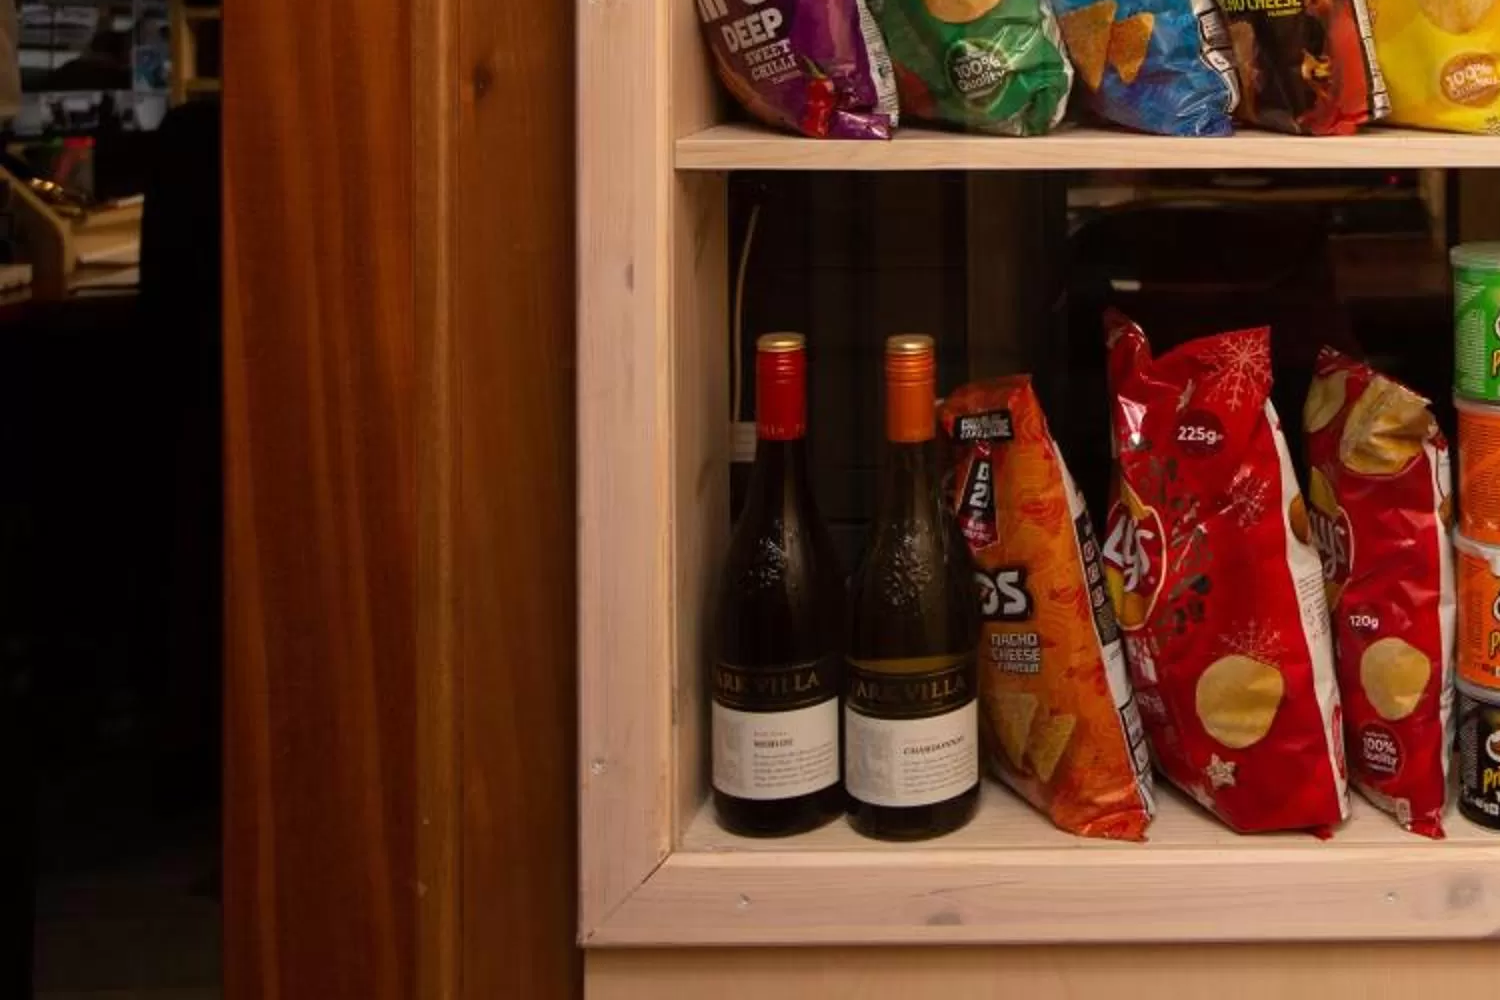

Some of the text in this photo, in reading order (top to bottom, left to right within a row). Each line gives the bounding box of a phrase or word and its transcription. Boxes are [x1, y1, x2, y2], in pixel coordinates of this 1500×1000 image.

[720, 7, 784, 54] DEEP
[744, 38, 791, 65] SWEET
[1177, 425, 1218, 445] 225g
[1349, 614, 1379, 631] 120g
